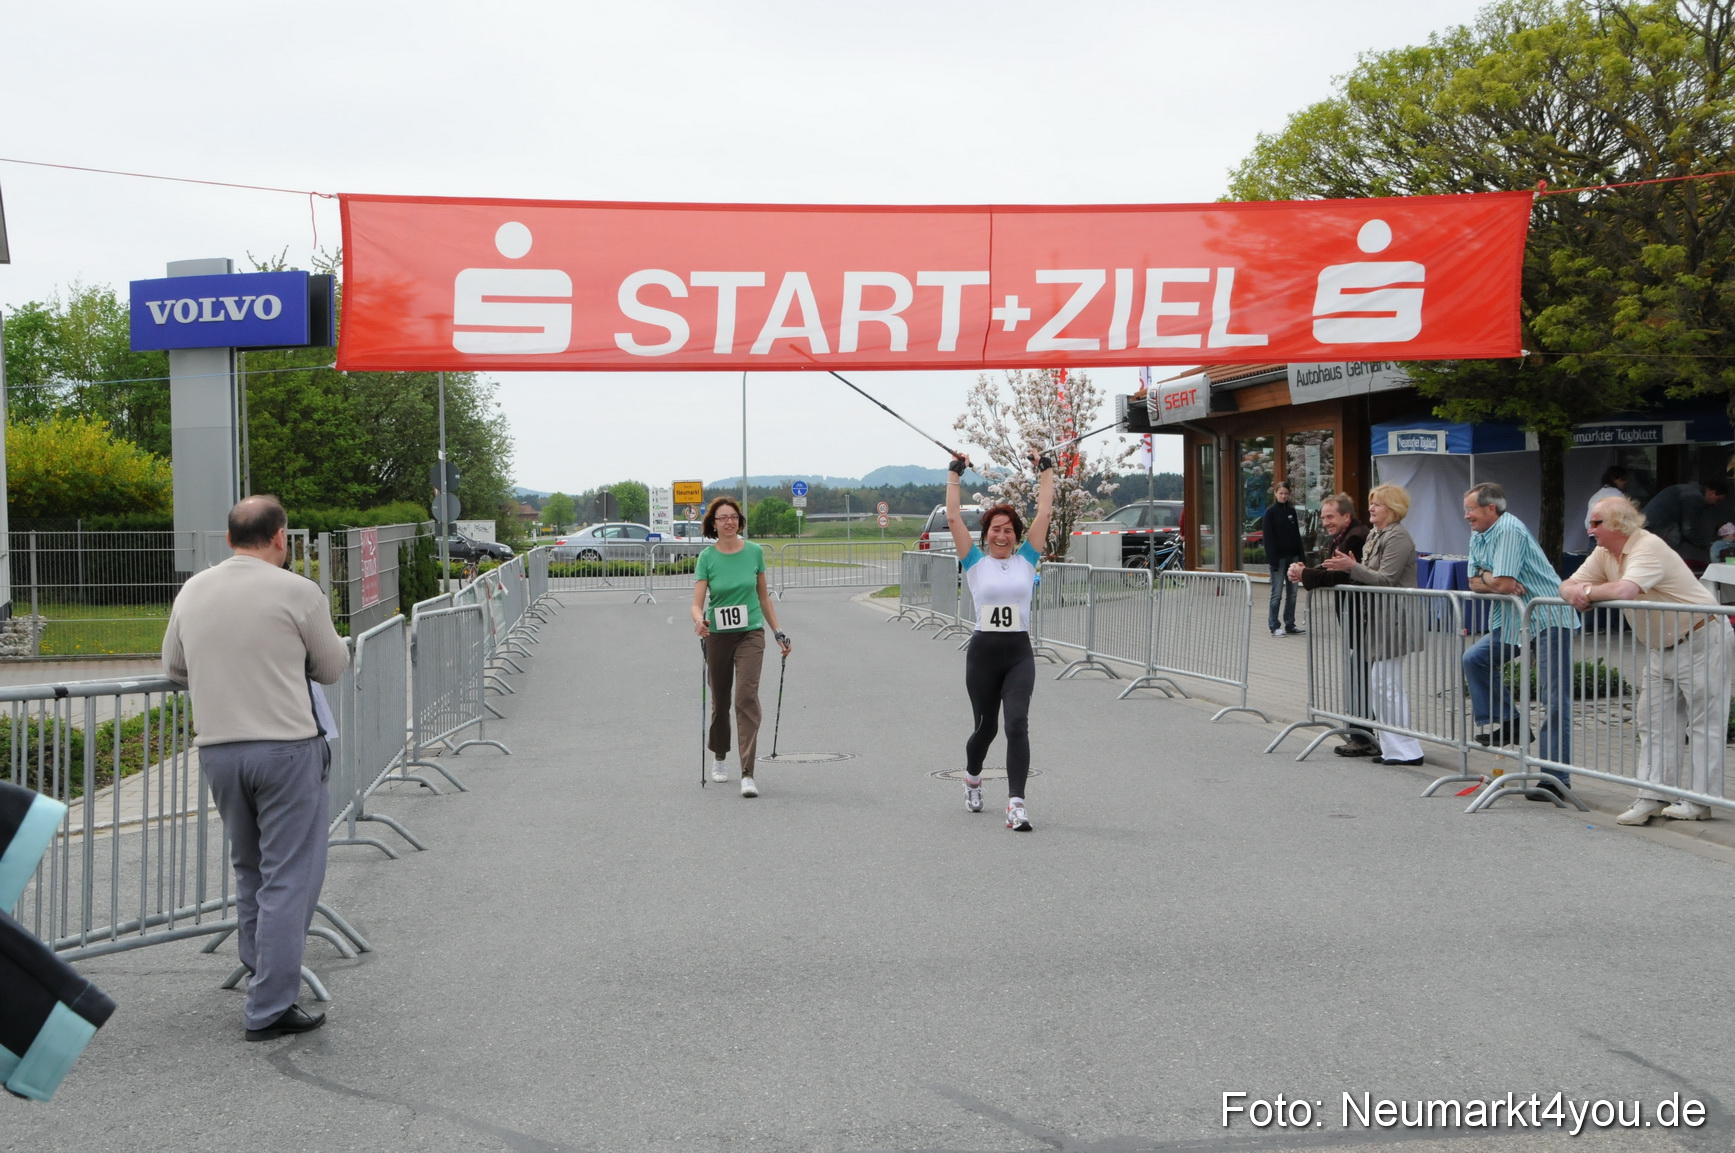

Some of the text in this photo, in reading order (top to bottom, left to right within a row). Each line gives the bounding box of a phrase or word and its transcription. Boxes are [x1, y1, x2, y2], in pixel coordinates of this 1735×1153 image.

[145, 294, 283, 325] VOLVO
[1296, 364, 1343, 388] Autohaus
[1164, 388, 1198, 410] SEAT
[1616, 428, 1658, 441] Tagblatt
[720, 607, 741, 626] 119
[990, 606, 1012, 627] 49
